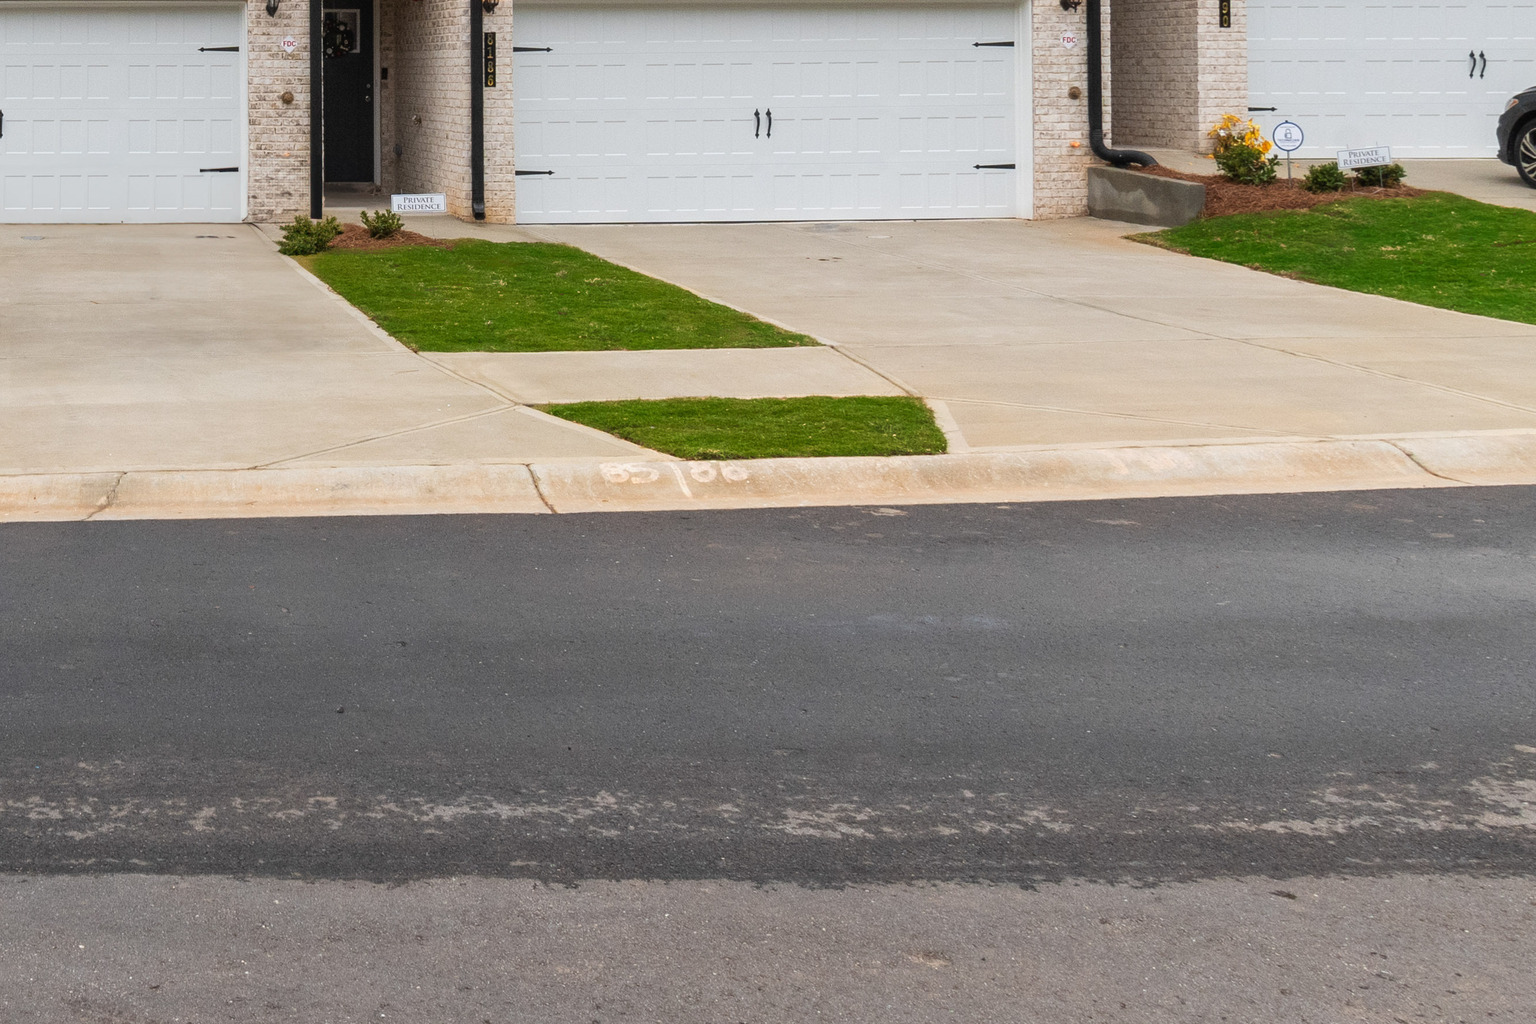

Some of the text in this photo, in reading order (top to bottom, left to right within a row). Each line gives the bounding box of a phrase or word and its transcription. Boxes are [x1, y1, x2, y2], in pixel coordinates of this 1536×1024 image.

[1348, 149, 1379, 159] PRIVATE
[1343, 155, 1387, 166] RESIDENCE
[397, 203, 441, 211] RESIDENCE
